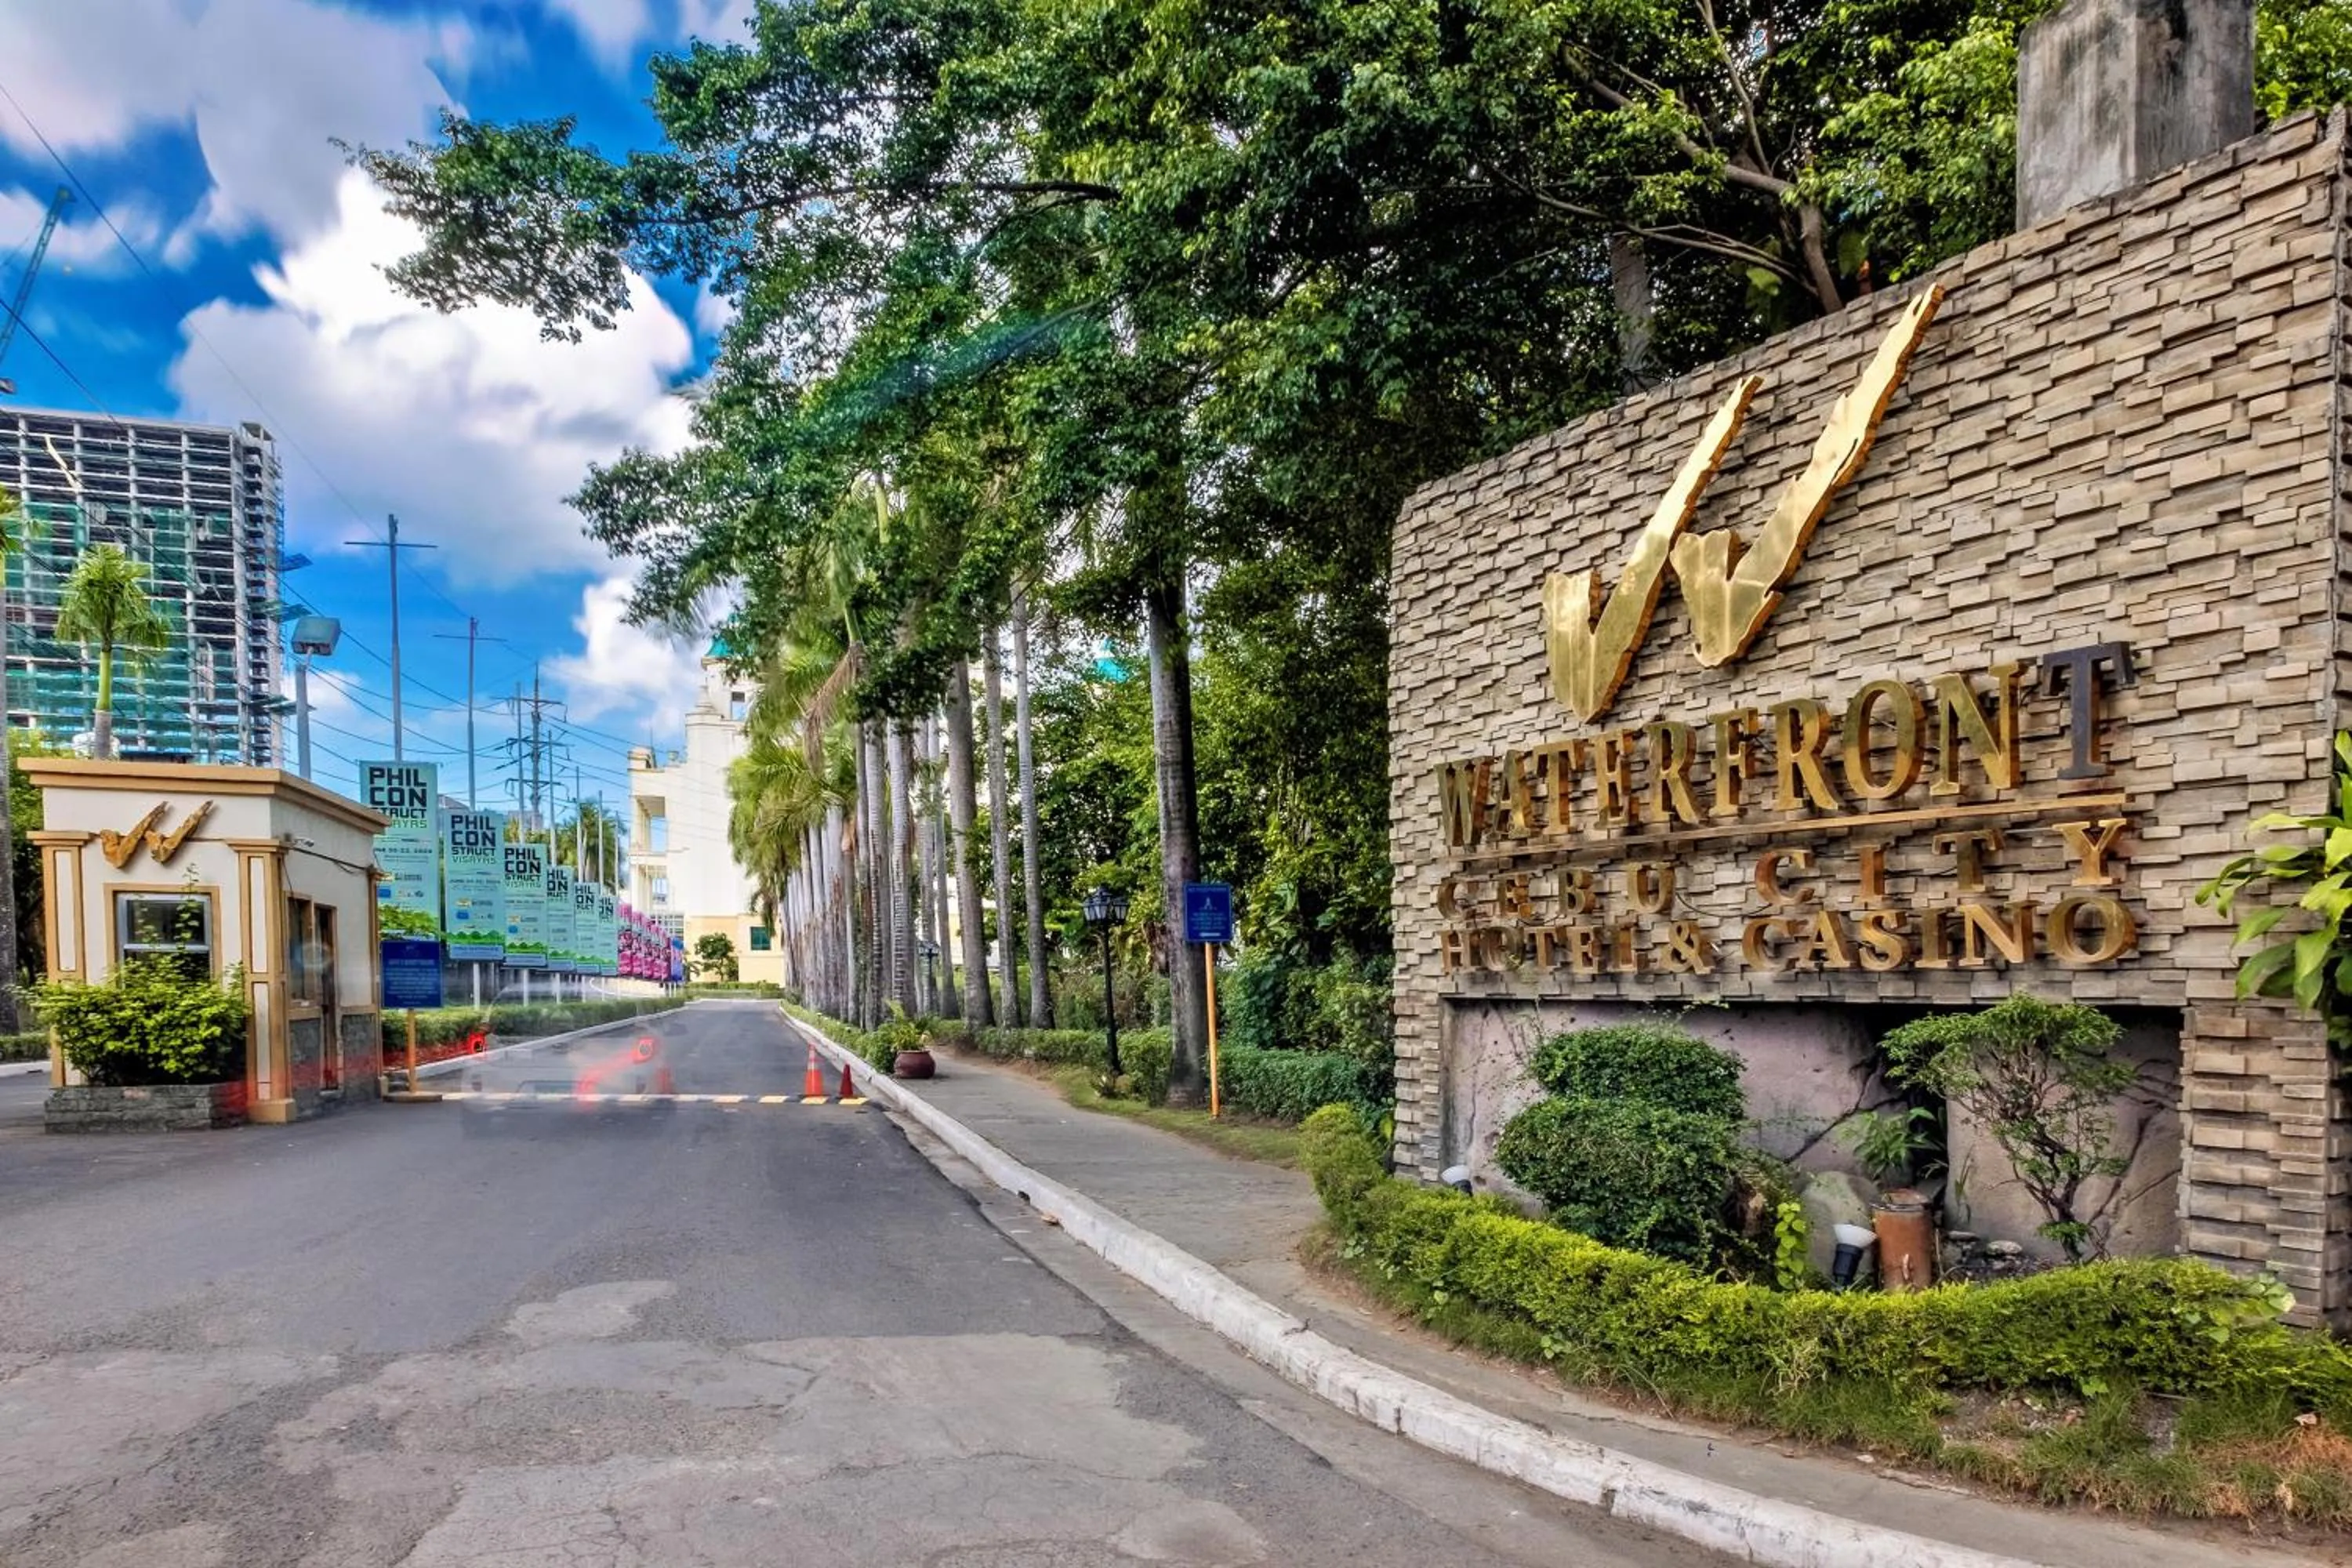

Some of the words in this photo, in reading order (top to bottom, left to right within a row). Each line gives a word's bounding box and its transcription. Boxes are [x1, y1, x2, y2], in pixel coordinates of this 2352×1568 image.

[1433, 641, 2138, 854] WATERFRONT
[369, 767, 427, 787] PHIL
[369, 786, 427, 808] CON
[370, 807, 427, 819] TRUCT
[451, 815, 495, 830] PHIL
[451, 830, 495, 847] CON
[451, 847, 495, 857] STRUCT
[504, 848, 541, 860] PHIL
[504, 860, 541, 873] CON
[1437, 862, 1676, 921] CEBU
[1755, 818, 2129, 908] CITY
[547, 869, 568, 880] HIL
[547, 880, 568, 891] ON
[575, 884, 593, 895] HIL
[576, 895, 595, 904] ON
[1440, 925, 1649, 975] HOTEL
[1660, 920, 1717, 975] &
[1742, 895, 2139, 972] CASINO
